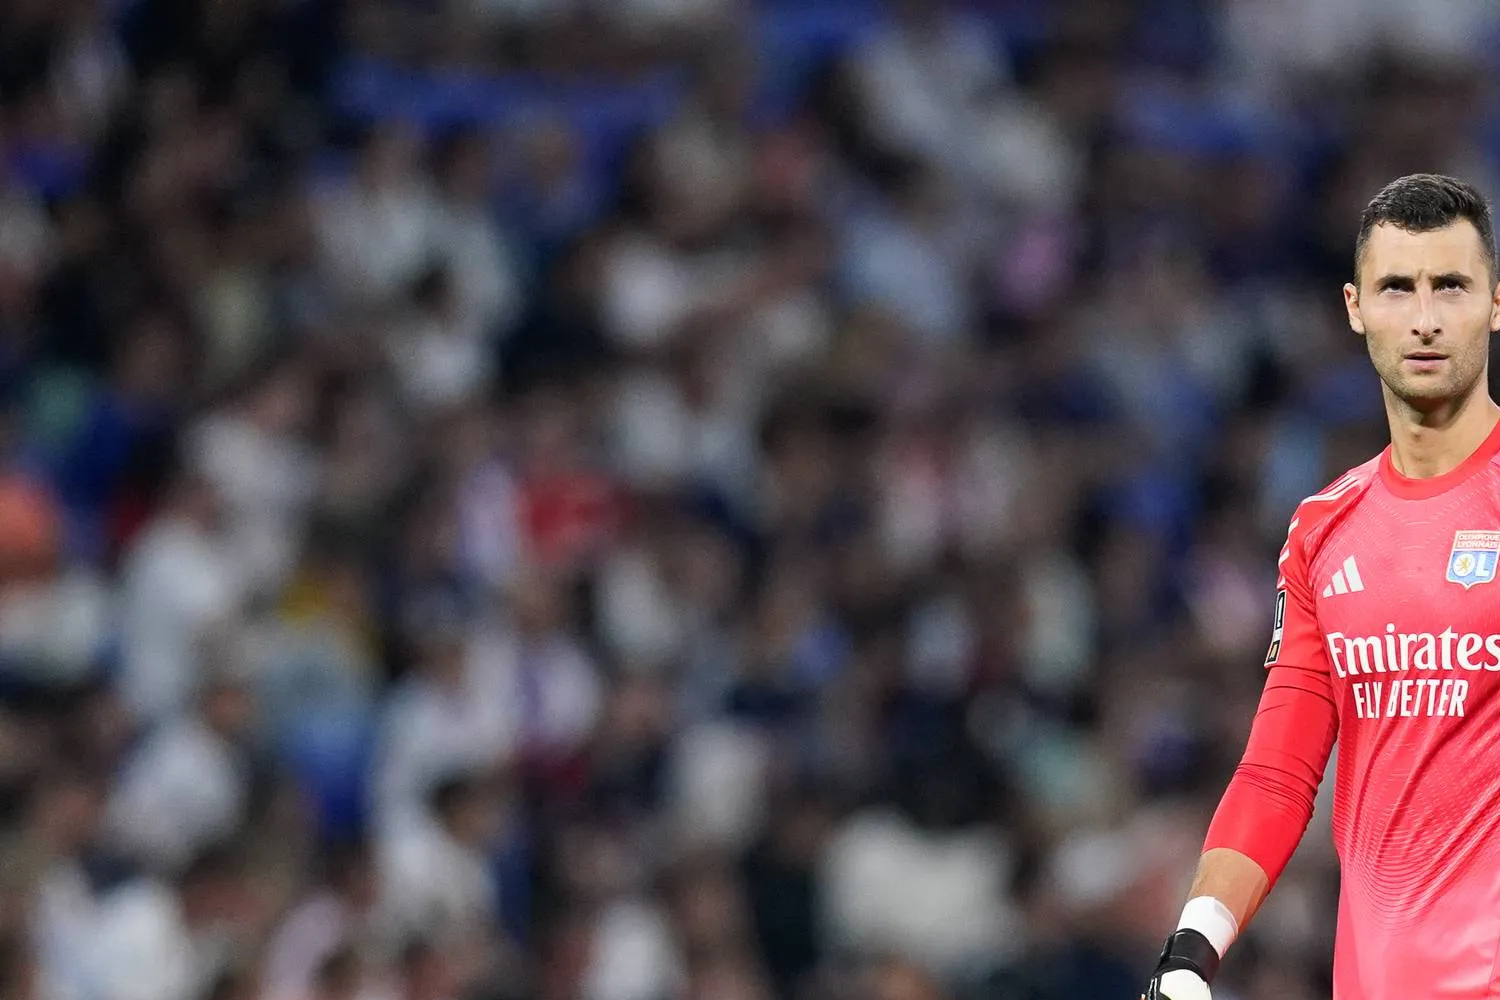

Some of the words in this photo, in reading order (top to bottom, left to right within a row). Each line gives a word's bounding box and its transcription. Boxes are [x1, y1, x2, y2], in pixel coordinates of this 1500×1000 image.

[1453, 553, 1489, 577] OL
[1352, 681, 1383, 719] FLY
[1386, 678, 1469, 718] BETTER
